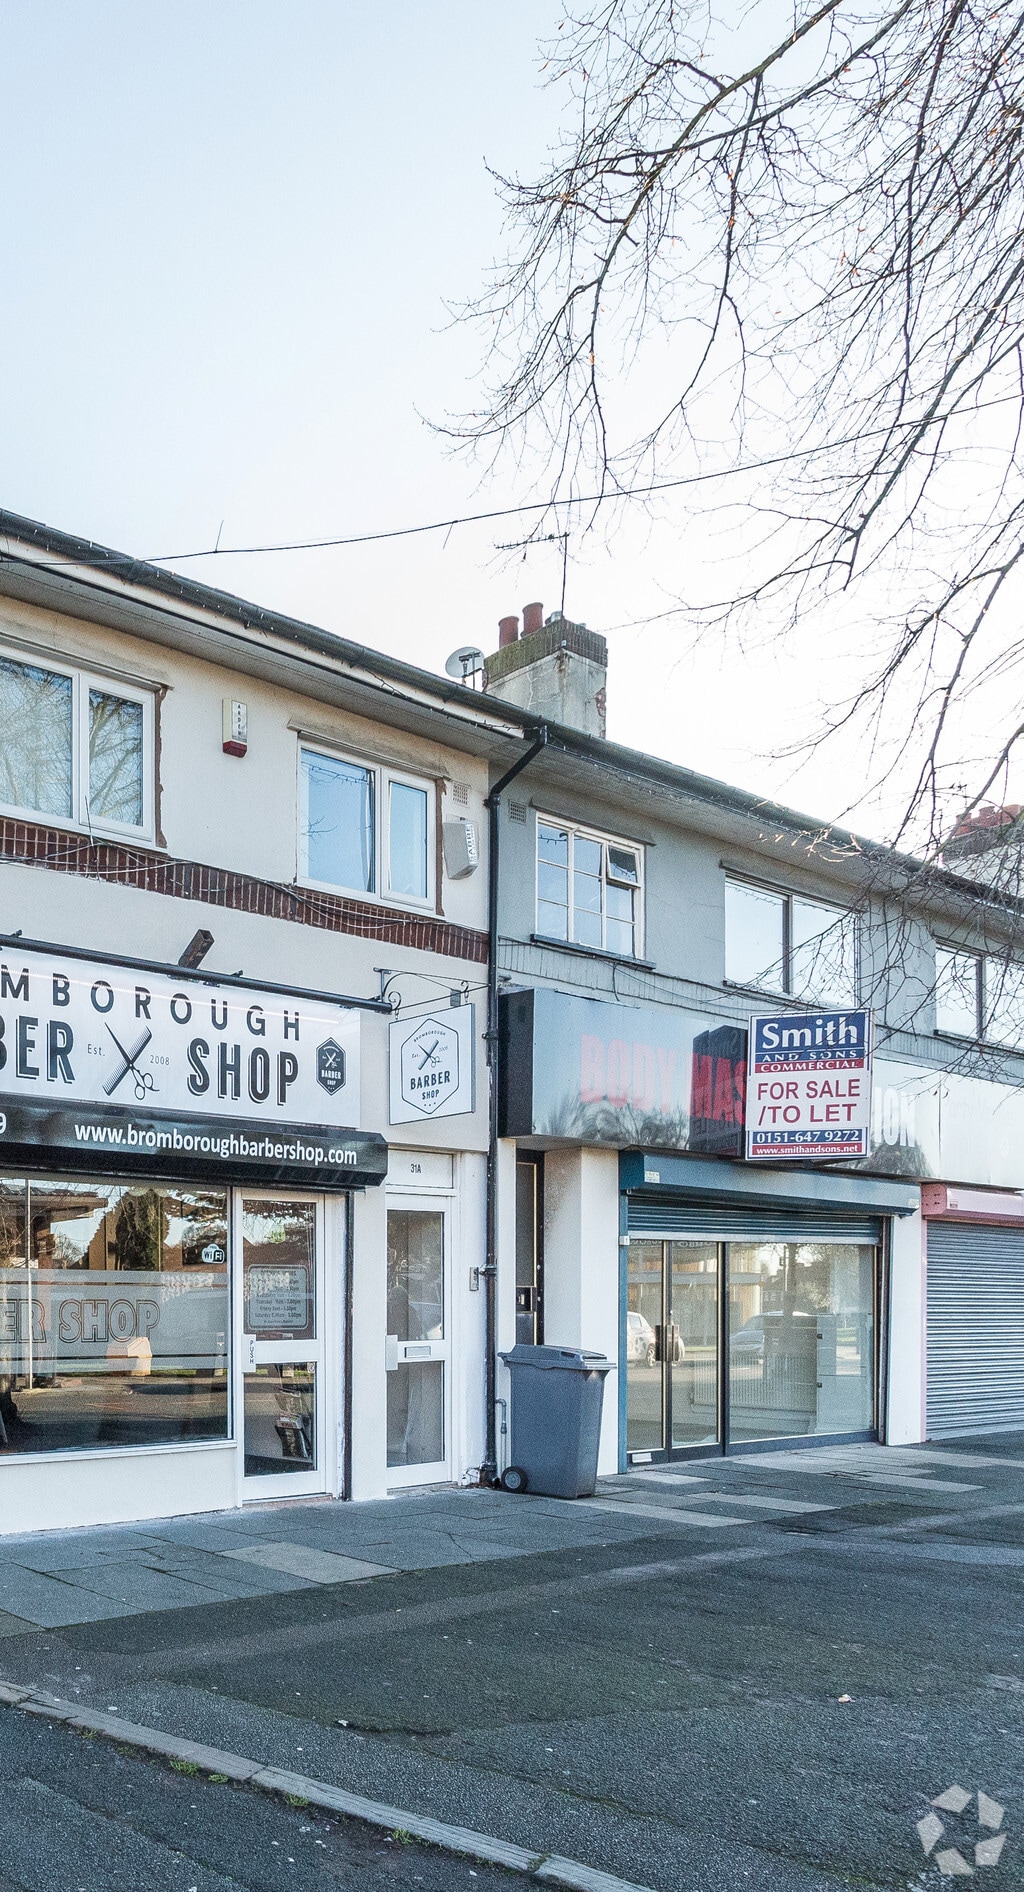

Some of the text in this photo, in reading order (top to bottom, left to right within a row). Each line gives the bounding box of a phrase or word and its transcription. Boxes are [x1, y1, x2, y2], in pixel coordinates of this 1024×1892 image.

[762, 1017, 858, 1049] Smith
[87, 1043, 170, 1066] Est. 2008
[760, 1060, 858, 1072] COMMERCIAL
[762, 1050, 858, 1063] AND SONS
[186, 1036, 300, 1105] SHOP
[410, 1070, 451, 1091] BARBER
[579, 1033, 676, 1114] BODY
[422, 1089, 440, 1101] SHOP
[757, 1078, 861, 1101] FOR SALE
[758, 1103, 857, 1126] /TO LET
[74, 1123, 358, 1166] www.bromboroughbarbershop.com
[756, 1130, 859, 1144] 0151-647 9272
[756, 1144, 859, 1155] www.smithandsons.net
[410, 1162, 422, 1174] 31A
[59, 1298, 161, 1344] SHOP
